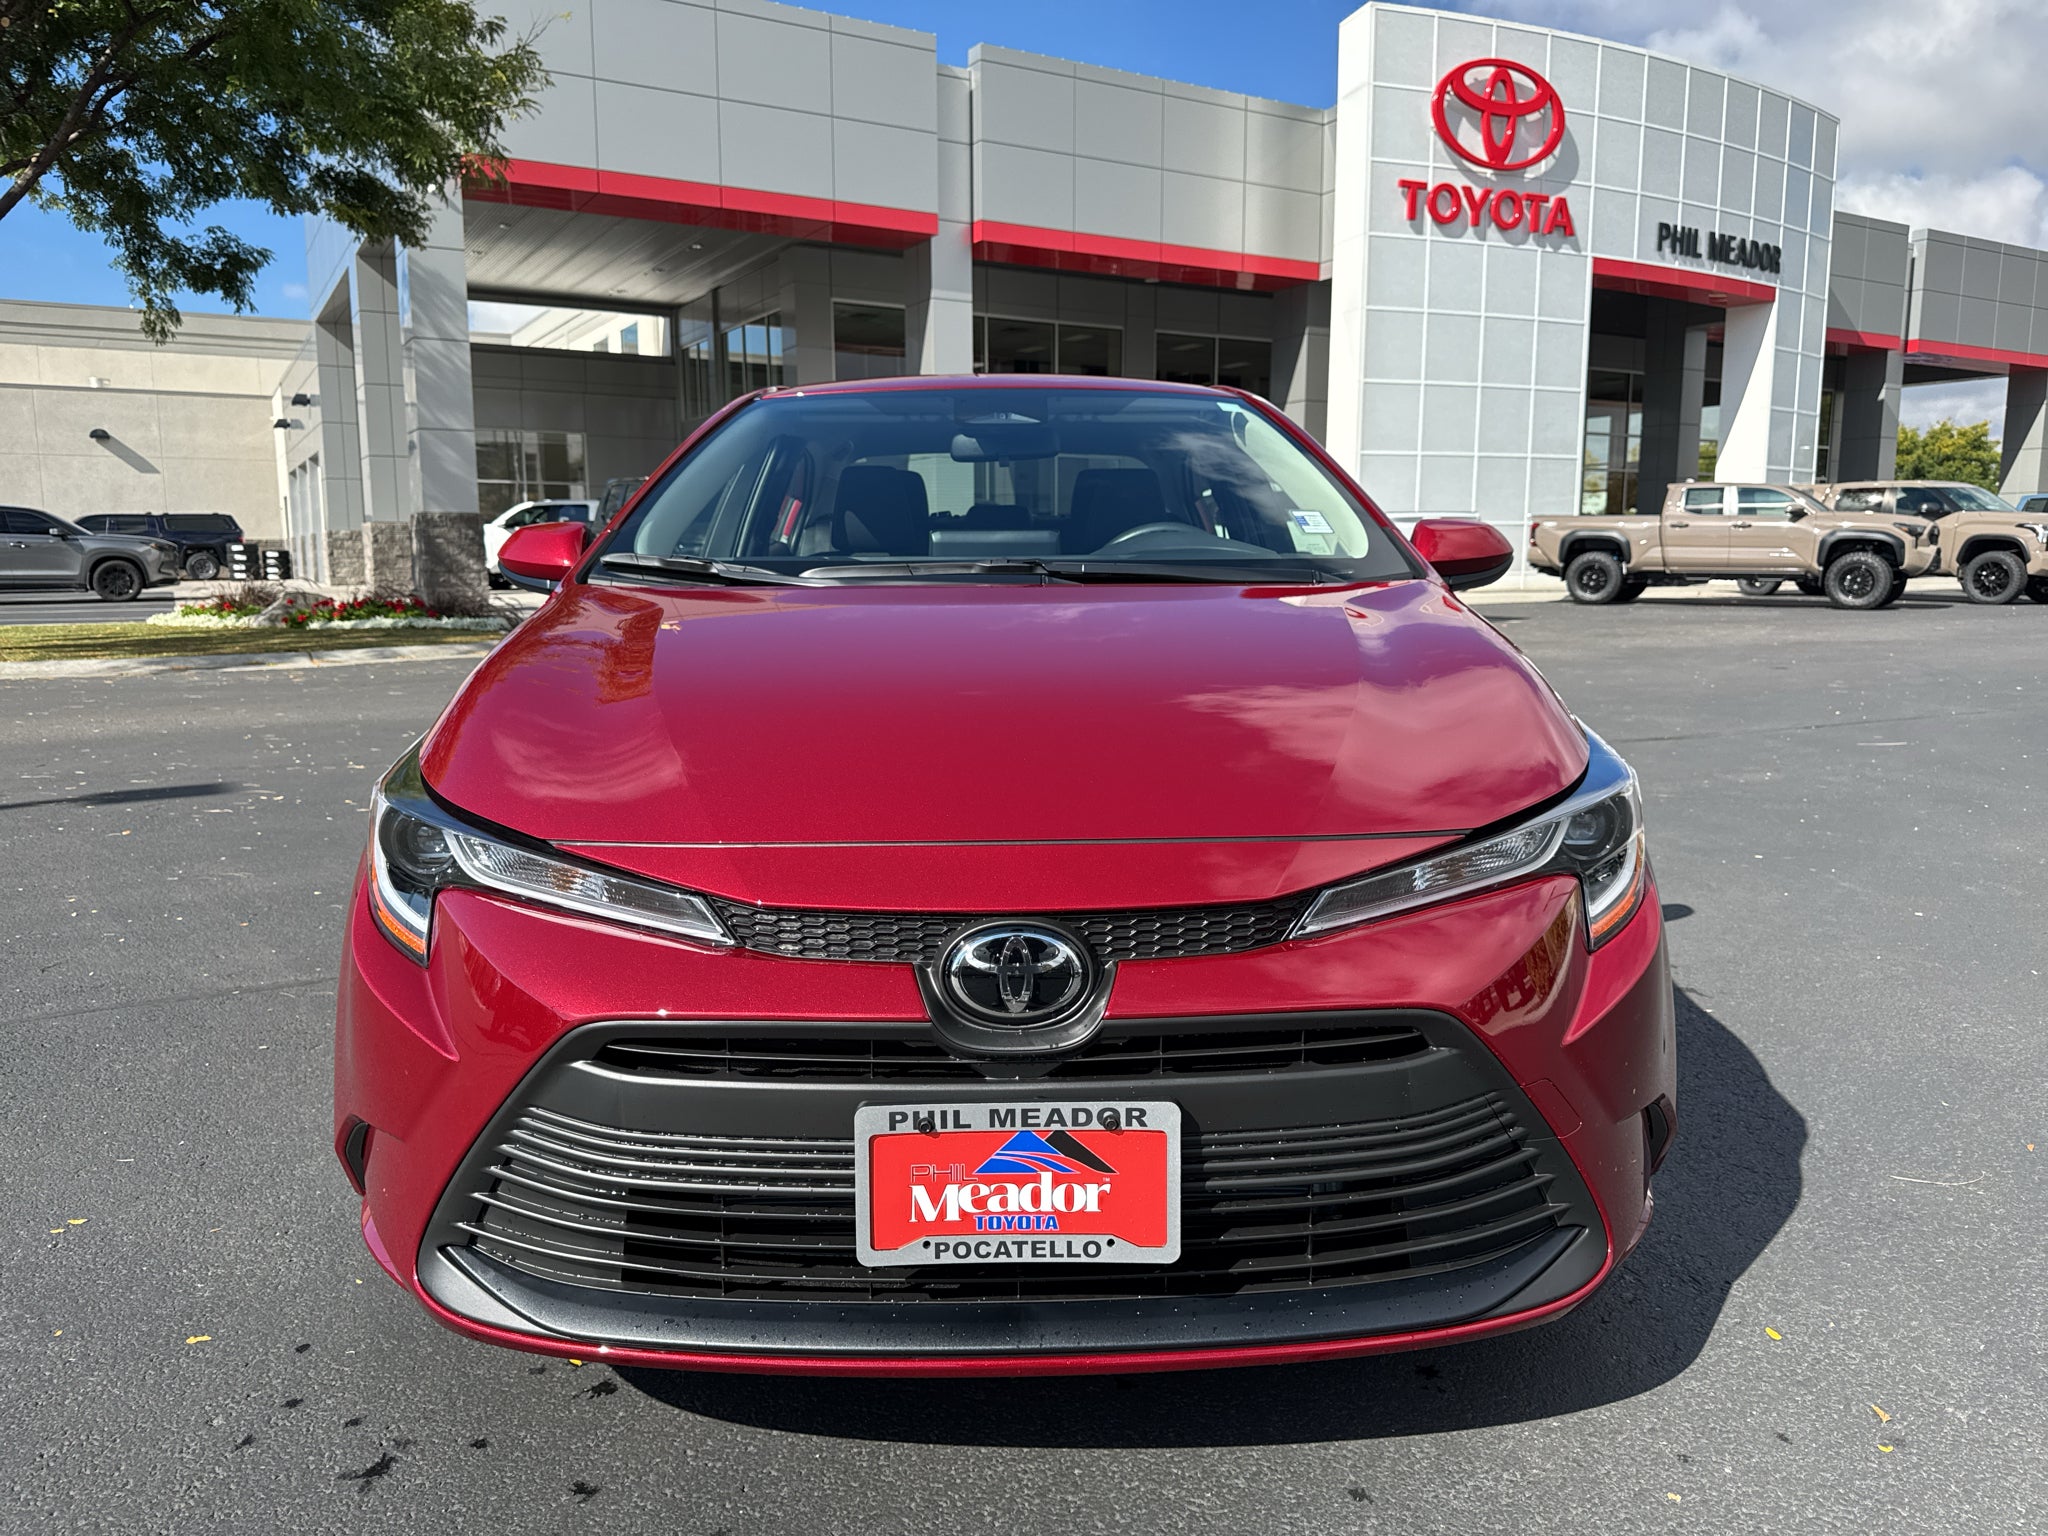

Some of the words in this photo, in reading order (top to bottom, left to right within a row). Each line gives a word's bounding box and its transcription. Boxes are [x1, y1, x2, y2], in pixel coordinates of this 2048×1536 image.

[1399, 179, 1575, 237] TOYOTA
[1657, 222, 1702, 258] PHIL
[1707, 231, 1782, 274] MEADOR
[911, 1164, 979, 1182] PHIL
[908, 1171, 1112, 1222] Meador
[973, 1215, 1060, 1231] TOYOTA
[934, 1240, 1103, 1260] POCATELLO
